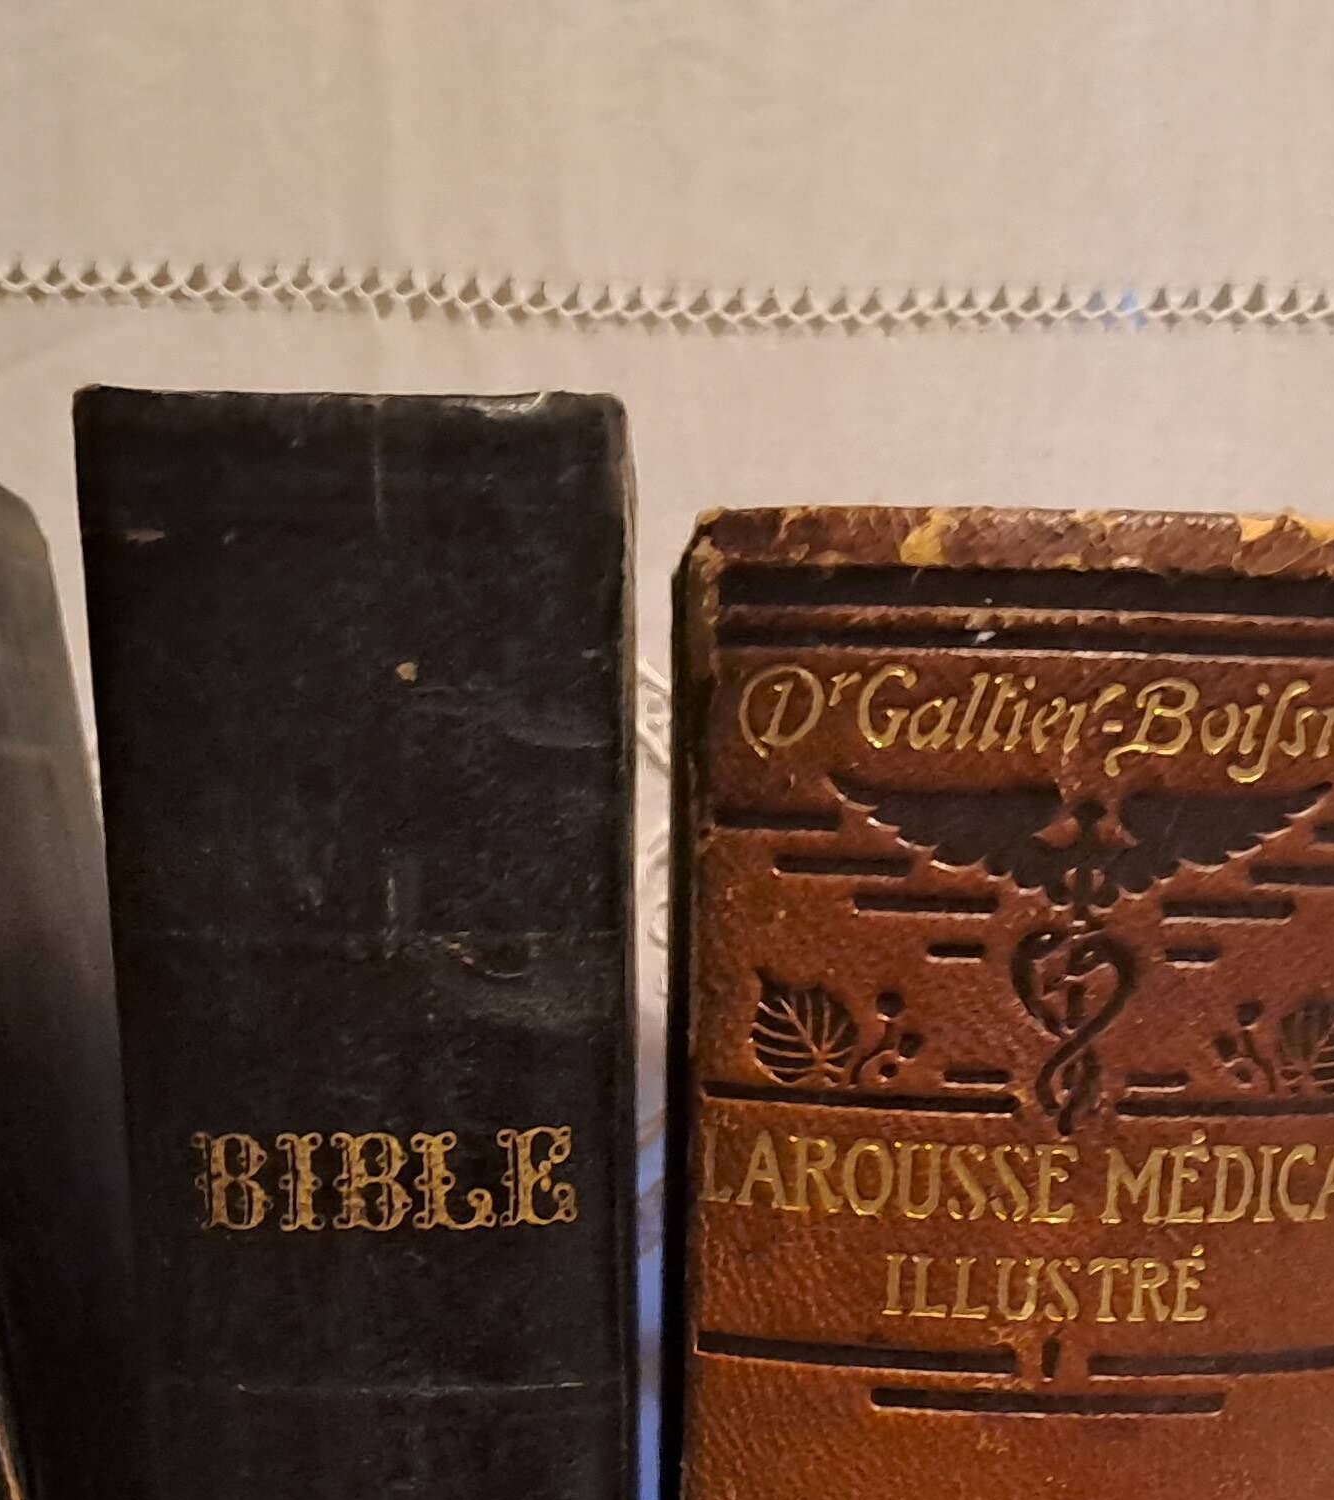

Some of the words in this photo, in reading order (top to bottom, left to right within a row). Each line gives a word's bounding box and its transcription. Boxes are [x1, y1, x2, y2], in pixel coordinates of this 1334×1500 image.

[738, 664, 860, 757] Dr
[191, 1126, 577, 1231] BIBLE
[700, 1125, 1080, 1225] LAROUSSE
[881, 1245, 1209, 1324] ILLUSTRÉ
